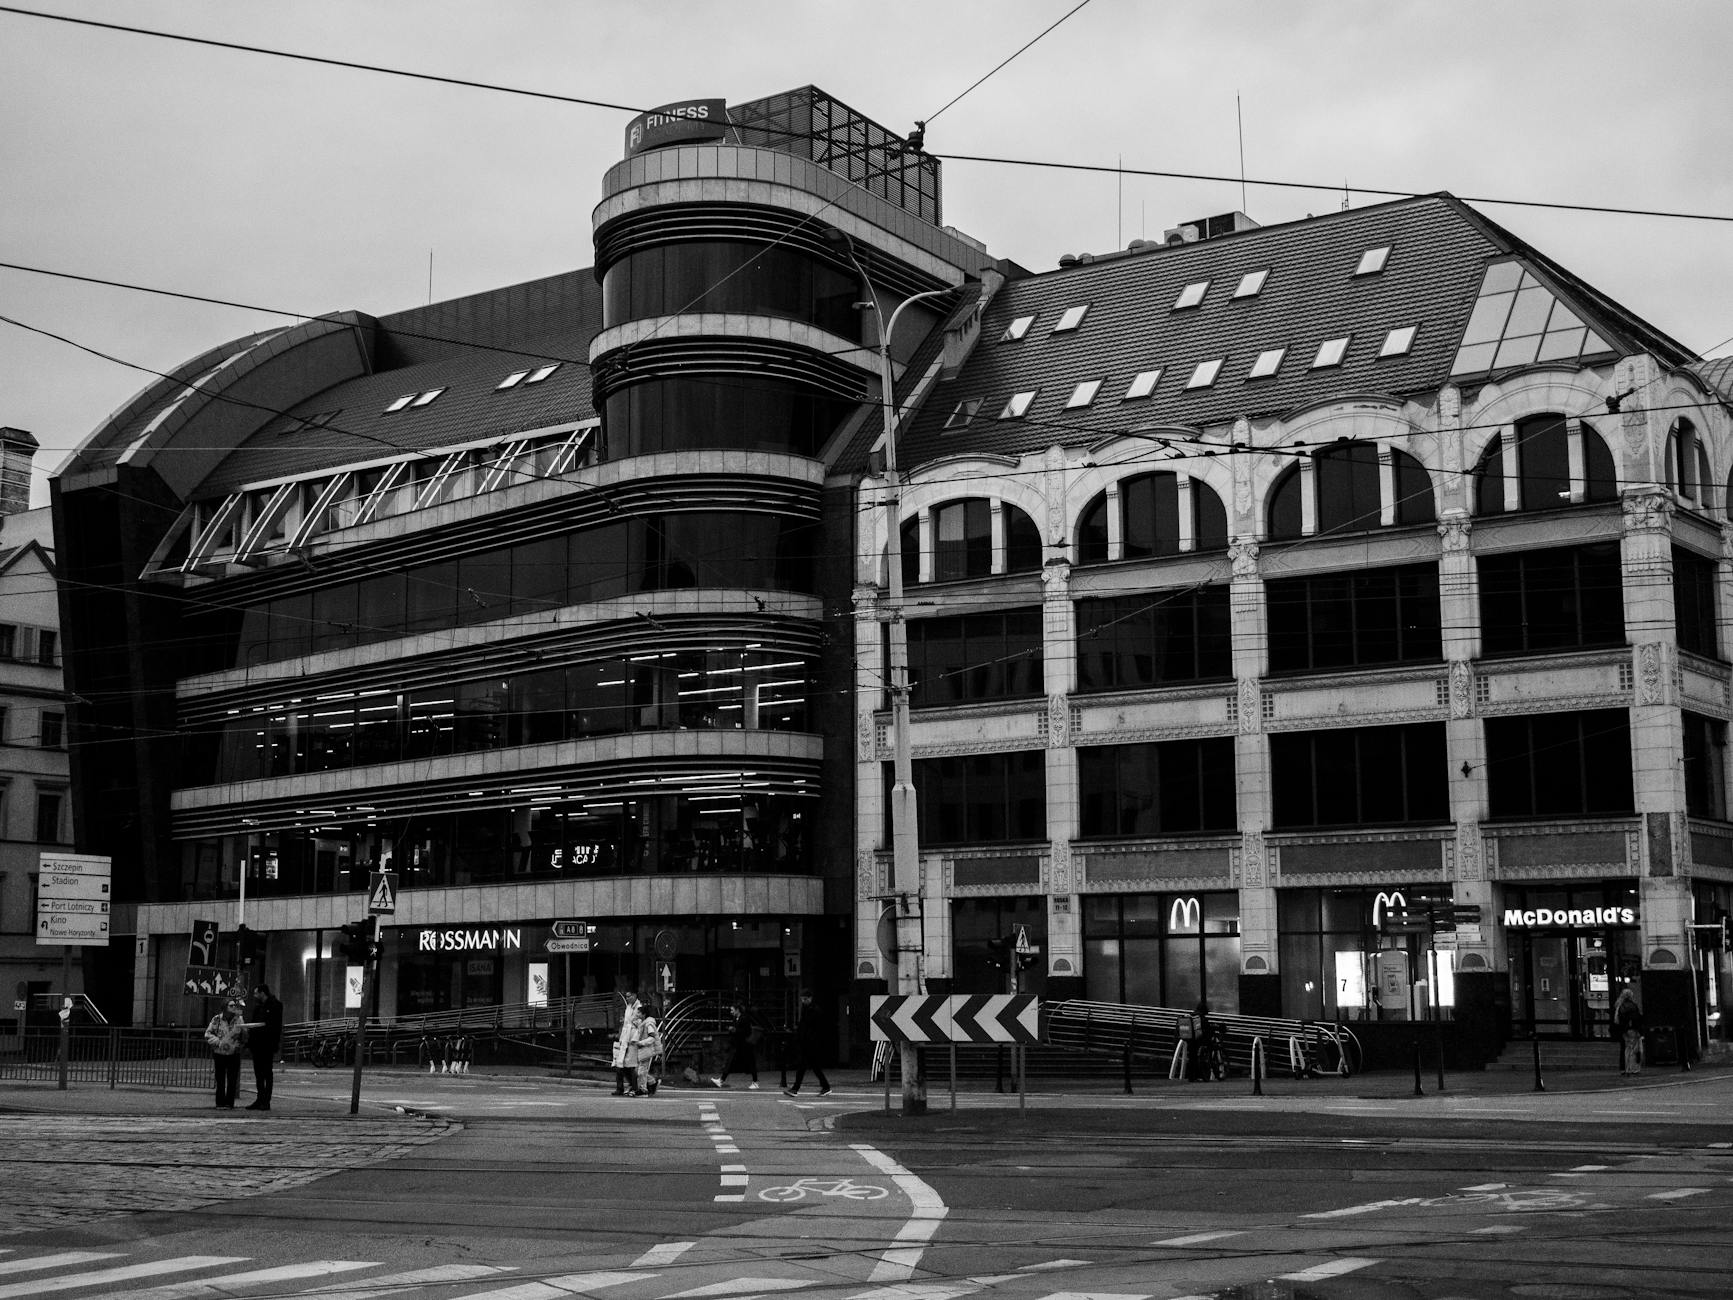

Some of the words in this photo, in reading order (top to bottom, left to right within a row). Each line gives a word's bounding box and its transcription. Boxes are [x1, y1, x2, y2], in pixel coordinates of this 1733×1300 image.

[646, 105, 709, 130] FITNESS
[52, 862, 83, 873] Szczepin
[51, 875, 79, 885] Stadion
[51, 901, 66, 910] Port
[67, 901, 95, 912] Lotniczy
[50, 915, 67, 924] Kino
[1503, 905, 1635, 927] McDonald's
[68, 929, 96, 937] Horyzonty
[418, 929, 521, 951] ROSSMANN
[551, 942, 588, 950] Obwodnica
